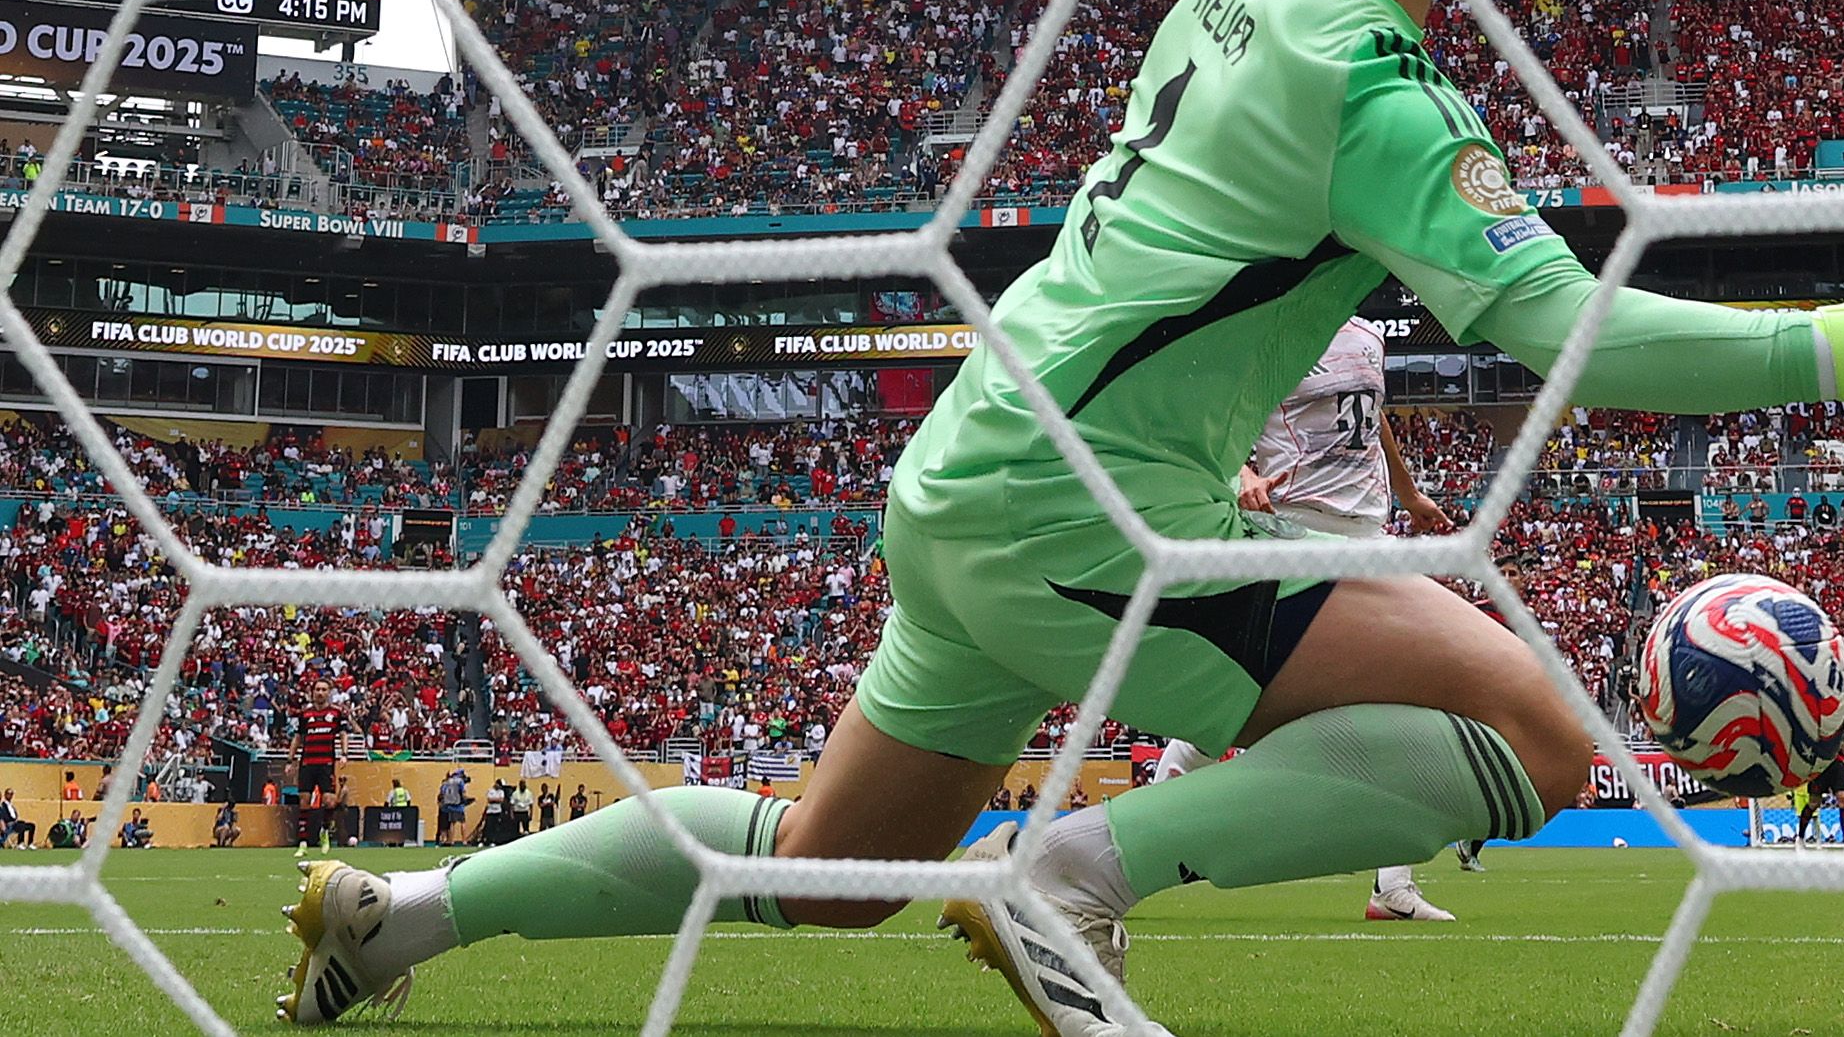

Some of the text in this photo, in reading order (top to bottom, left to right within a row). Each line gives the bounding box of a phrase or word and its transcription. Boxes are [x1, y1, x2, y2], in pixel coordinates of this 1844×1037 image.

[335, 0, 367, 23] PM
[333, 64, 368, 84] 355
[119, 198, 163, 220] 17-0
[1535, 190, 1564, 208] 75
[371, 220, 404, 239] VIII
[91, 321, 134, 341] FIFA
[138, 324, 189, 345] CLUB
[193, 328, 264, 350] WORLD
[267, 333, 307, 352] CUP
[774, 331, 981, 354] FIFA CLUB WORLD CU
[478, 345, 527, 362] CLUB
[605, 341, 643, 359] CUP
